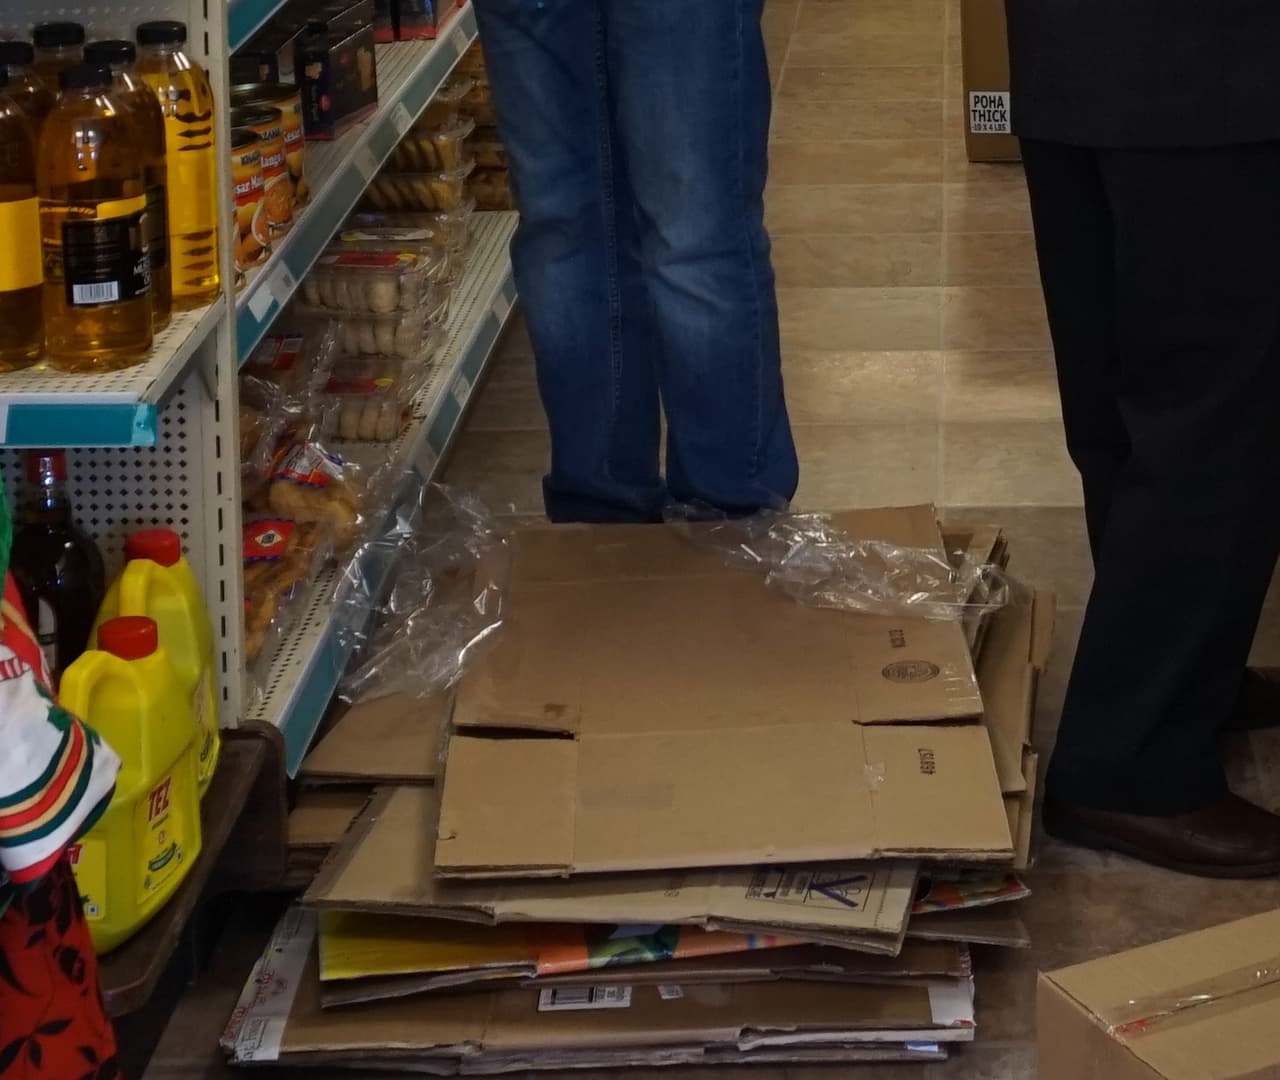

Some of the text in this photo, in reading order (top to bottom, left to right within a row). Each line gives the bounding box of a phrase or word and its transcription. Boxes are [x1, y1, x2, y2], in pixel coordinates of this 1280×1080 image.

[973, 95, 1004, 109] POHA
[971, 109, 1008, 122] THICK
[148, 775, 172, 823] TEZ
